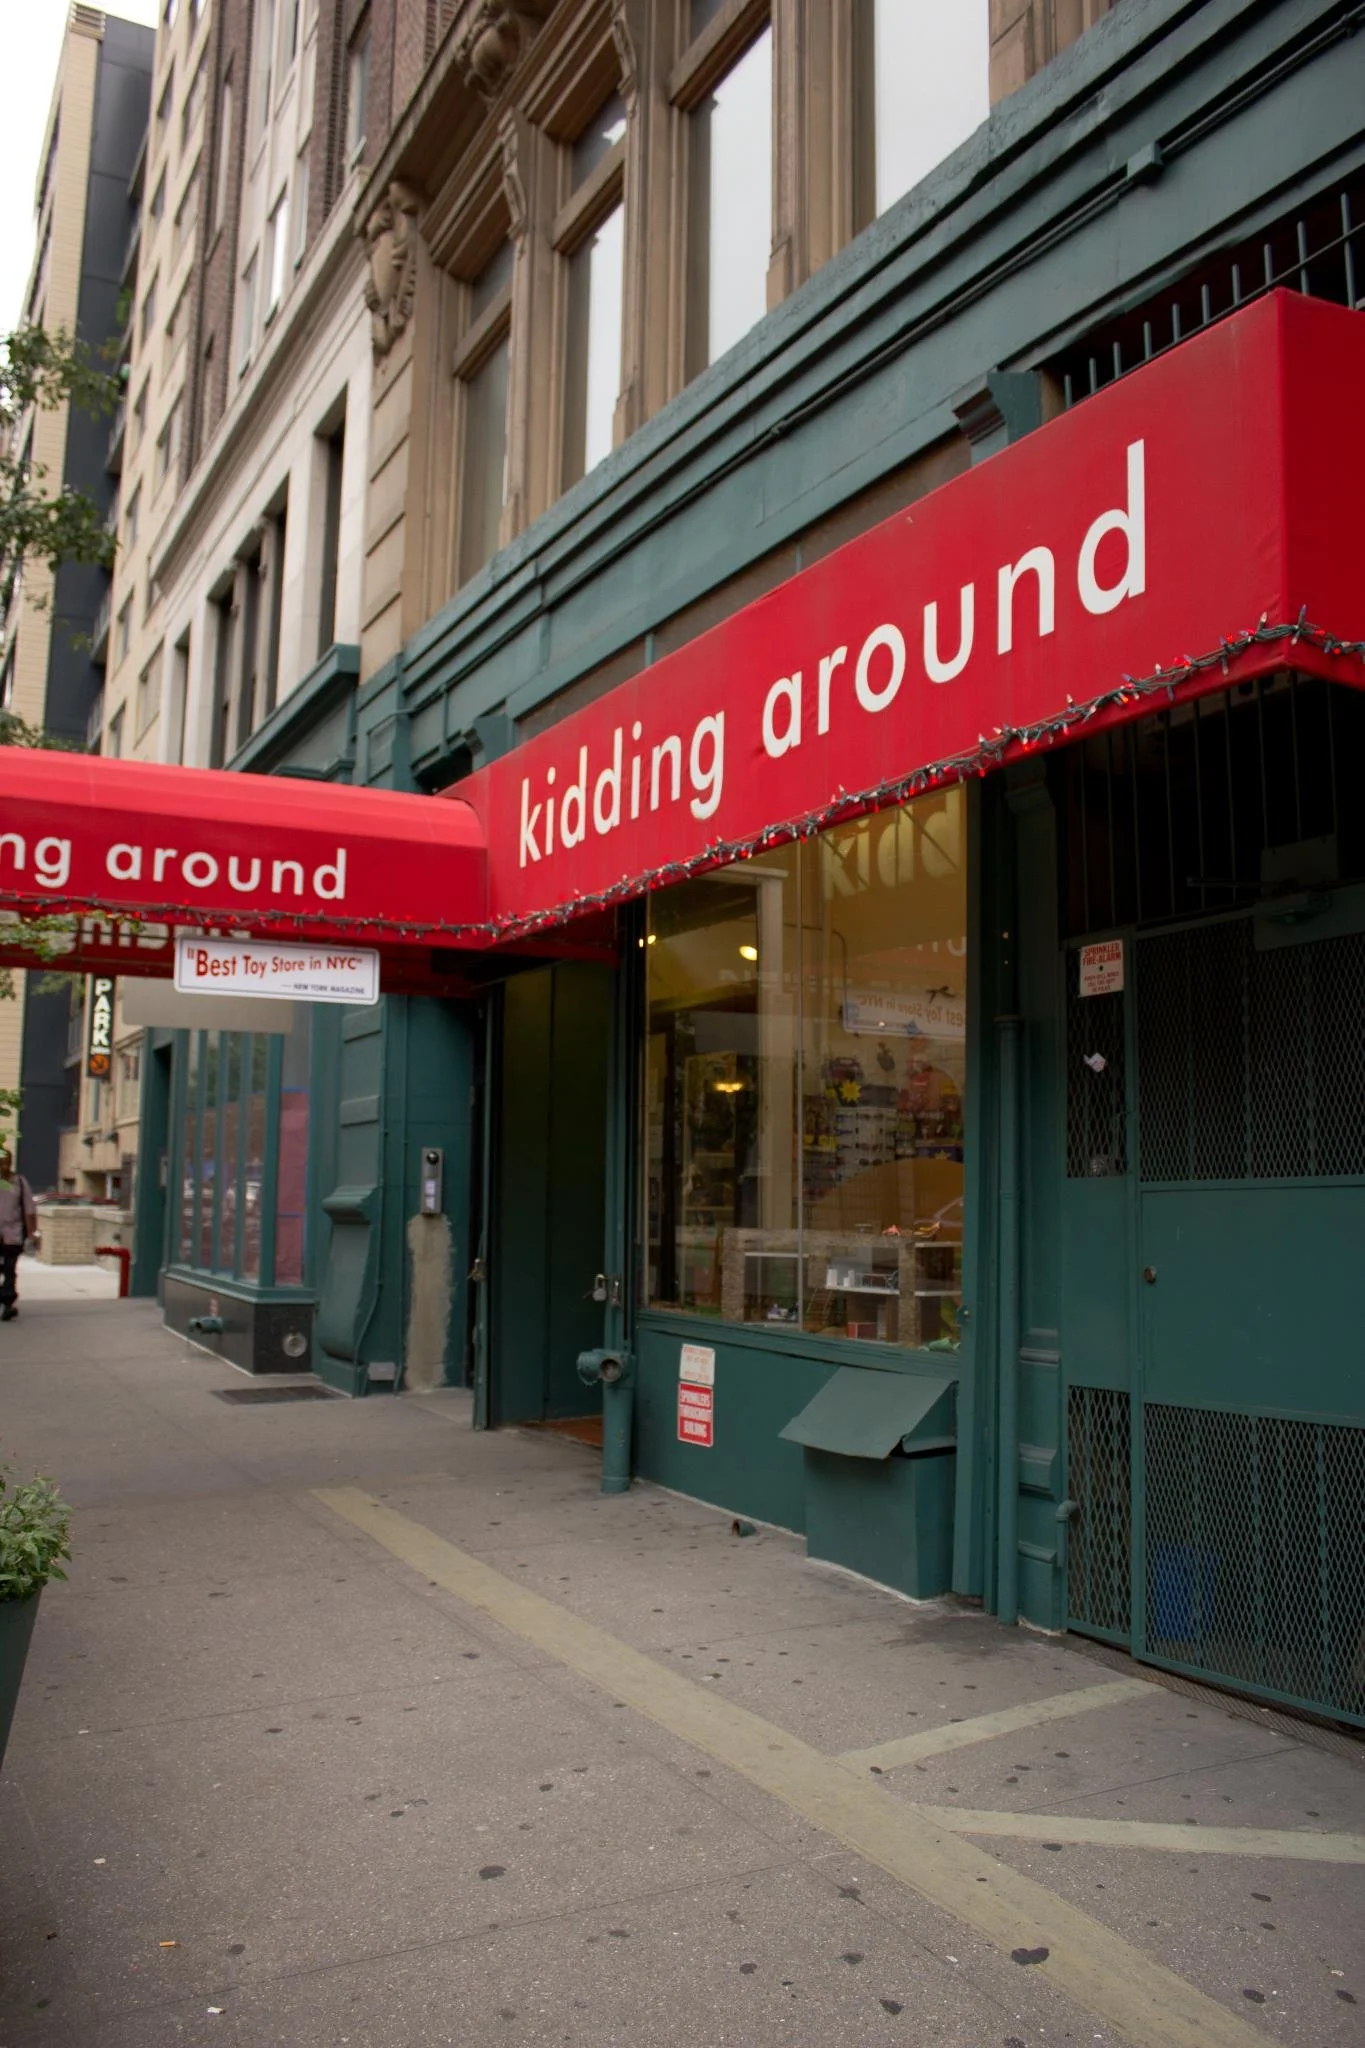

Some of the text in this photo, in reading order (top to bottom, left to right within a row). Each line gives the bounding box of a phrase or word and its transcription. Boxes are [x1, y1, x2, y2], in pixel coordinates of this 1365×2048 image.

[518, 438, 1146, 869] kidding around
[106, 843, 347, 900] around
[242, 955, 267, 979] Toy
[271, 956, 305, 973] Store
[309, 955, 322, 970] in
[93, 978, 112, 1046] PARK
